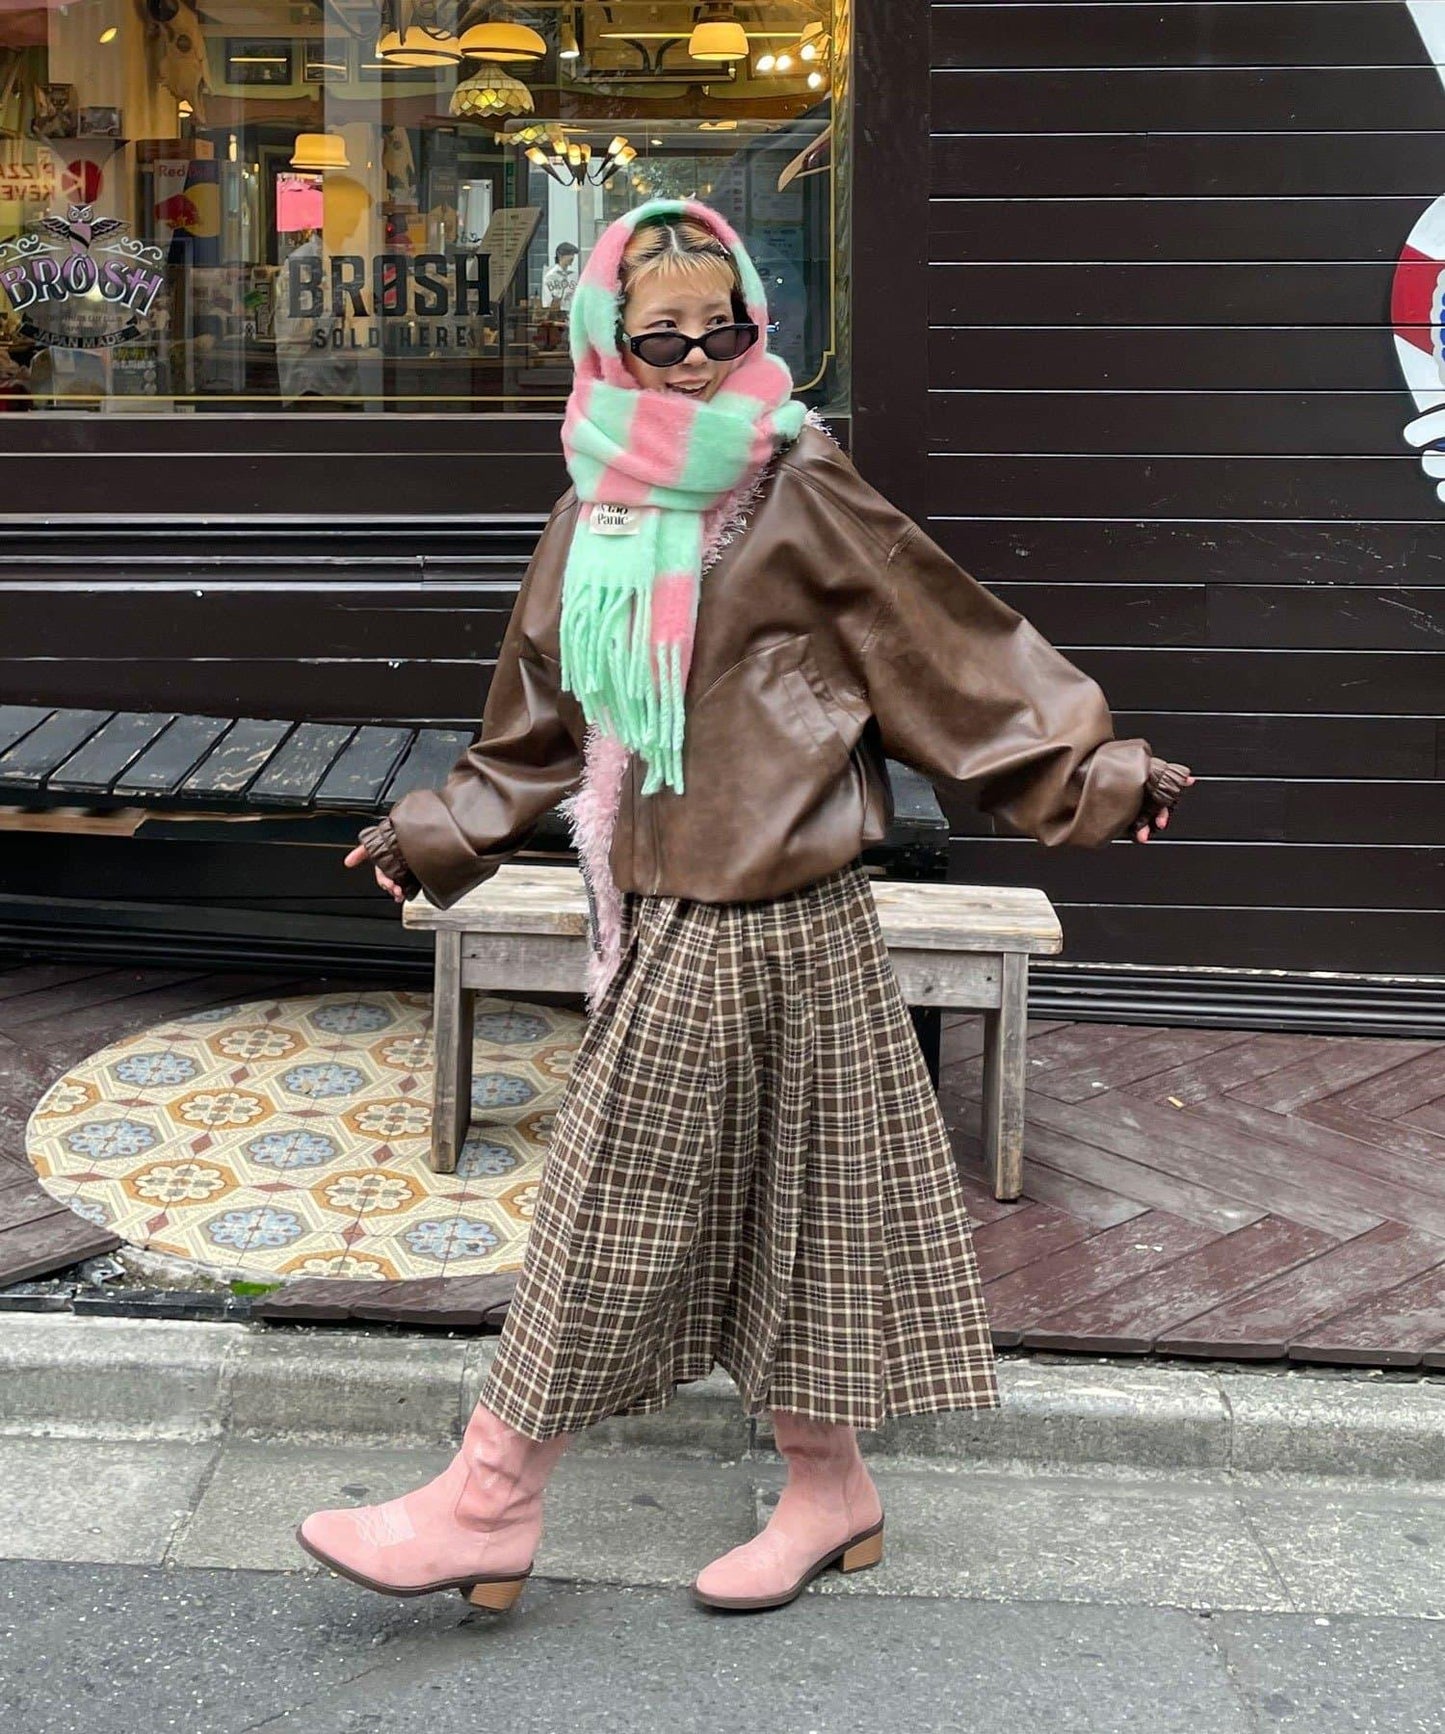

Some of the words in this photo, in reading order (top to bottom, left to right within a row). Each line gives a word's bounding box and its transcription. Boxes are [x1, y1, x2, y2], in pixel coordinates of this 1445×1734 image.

[158, 164, 186, 178] Red
[34, 330, 79, 348] JAPAN
[83, 333, 125, 348] MADE
[313, 327, 380, 349] SOLD
[401, 326, 467, 348] HERE
[598, 513, 628, 525] Panic
